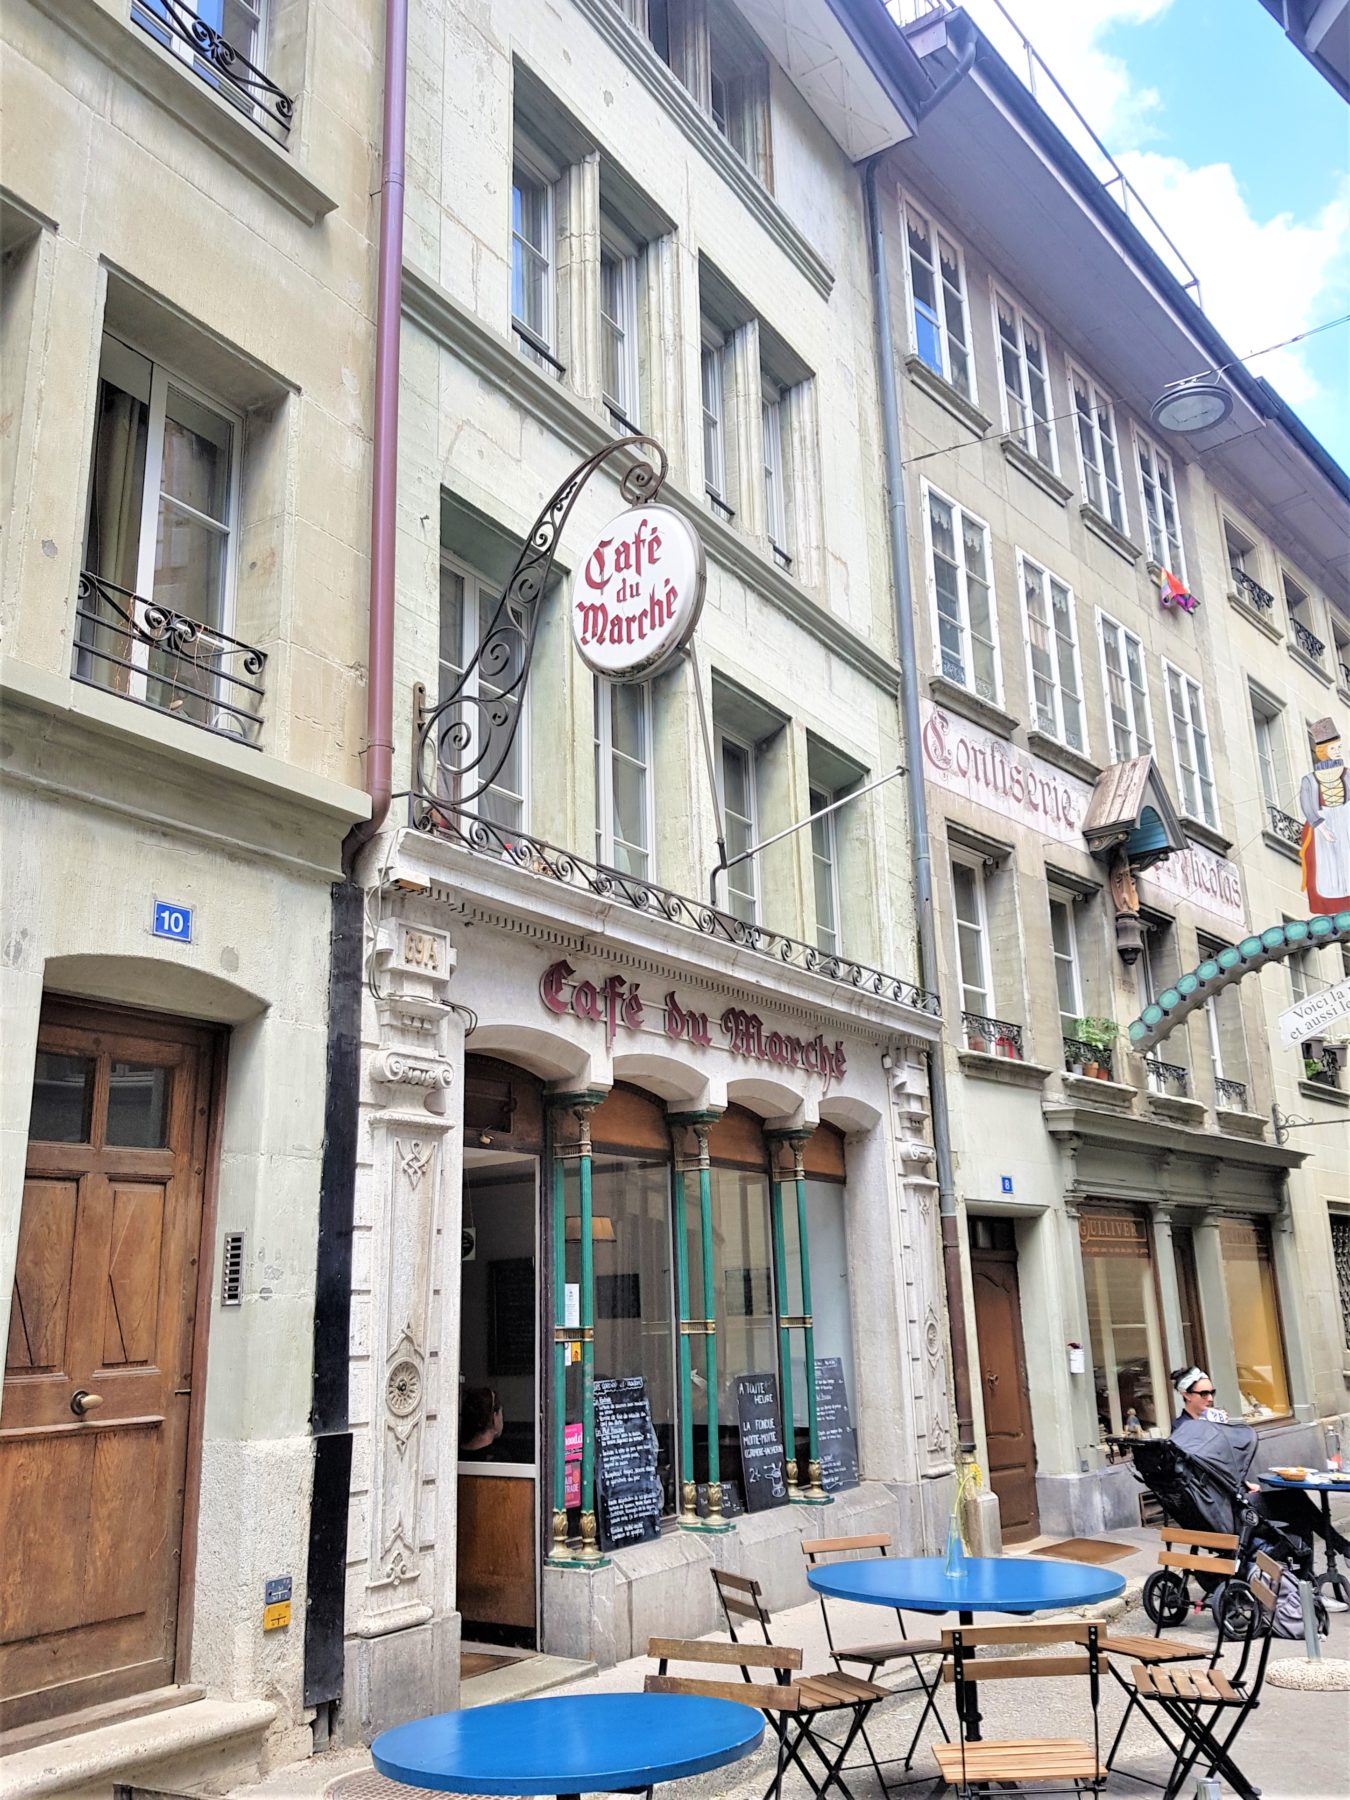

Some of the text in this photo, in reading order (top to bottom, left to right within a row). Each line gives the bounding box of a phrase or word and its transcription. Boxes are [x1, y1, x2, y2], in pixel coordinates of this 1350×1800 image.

[585, 519, 662, 595] Café
[616, 578, 641, 603] du
[575, 578, 679, 646] Marché
[923, 708, 1075, 831] Confiserie
[160, 910, 184, 933] 10
[1293, 991, 1345, 1018] Voici la
[540, 959, 848, 1093] Café du Marché
[1290, 1027, 1304, 1040] et
[1304, 1004, 1338, 1030] aussi
[1004, 1179, 1011, 1190] 8
[1079, 1218, 1138, 1237] GULLIVER
[745, 1382, 766, 1394] TOUTE
[754, 1393, 774, 1405] HEURE
[743, 1418, 775, 1431] LA FONDUE
